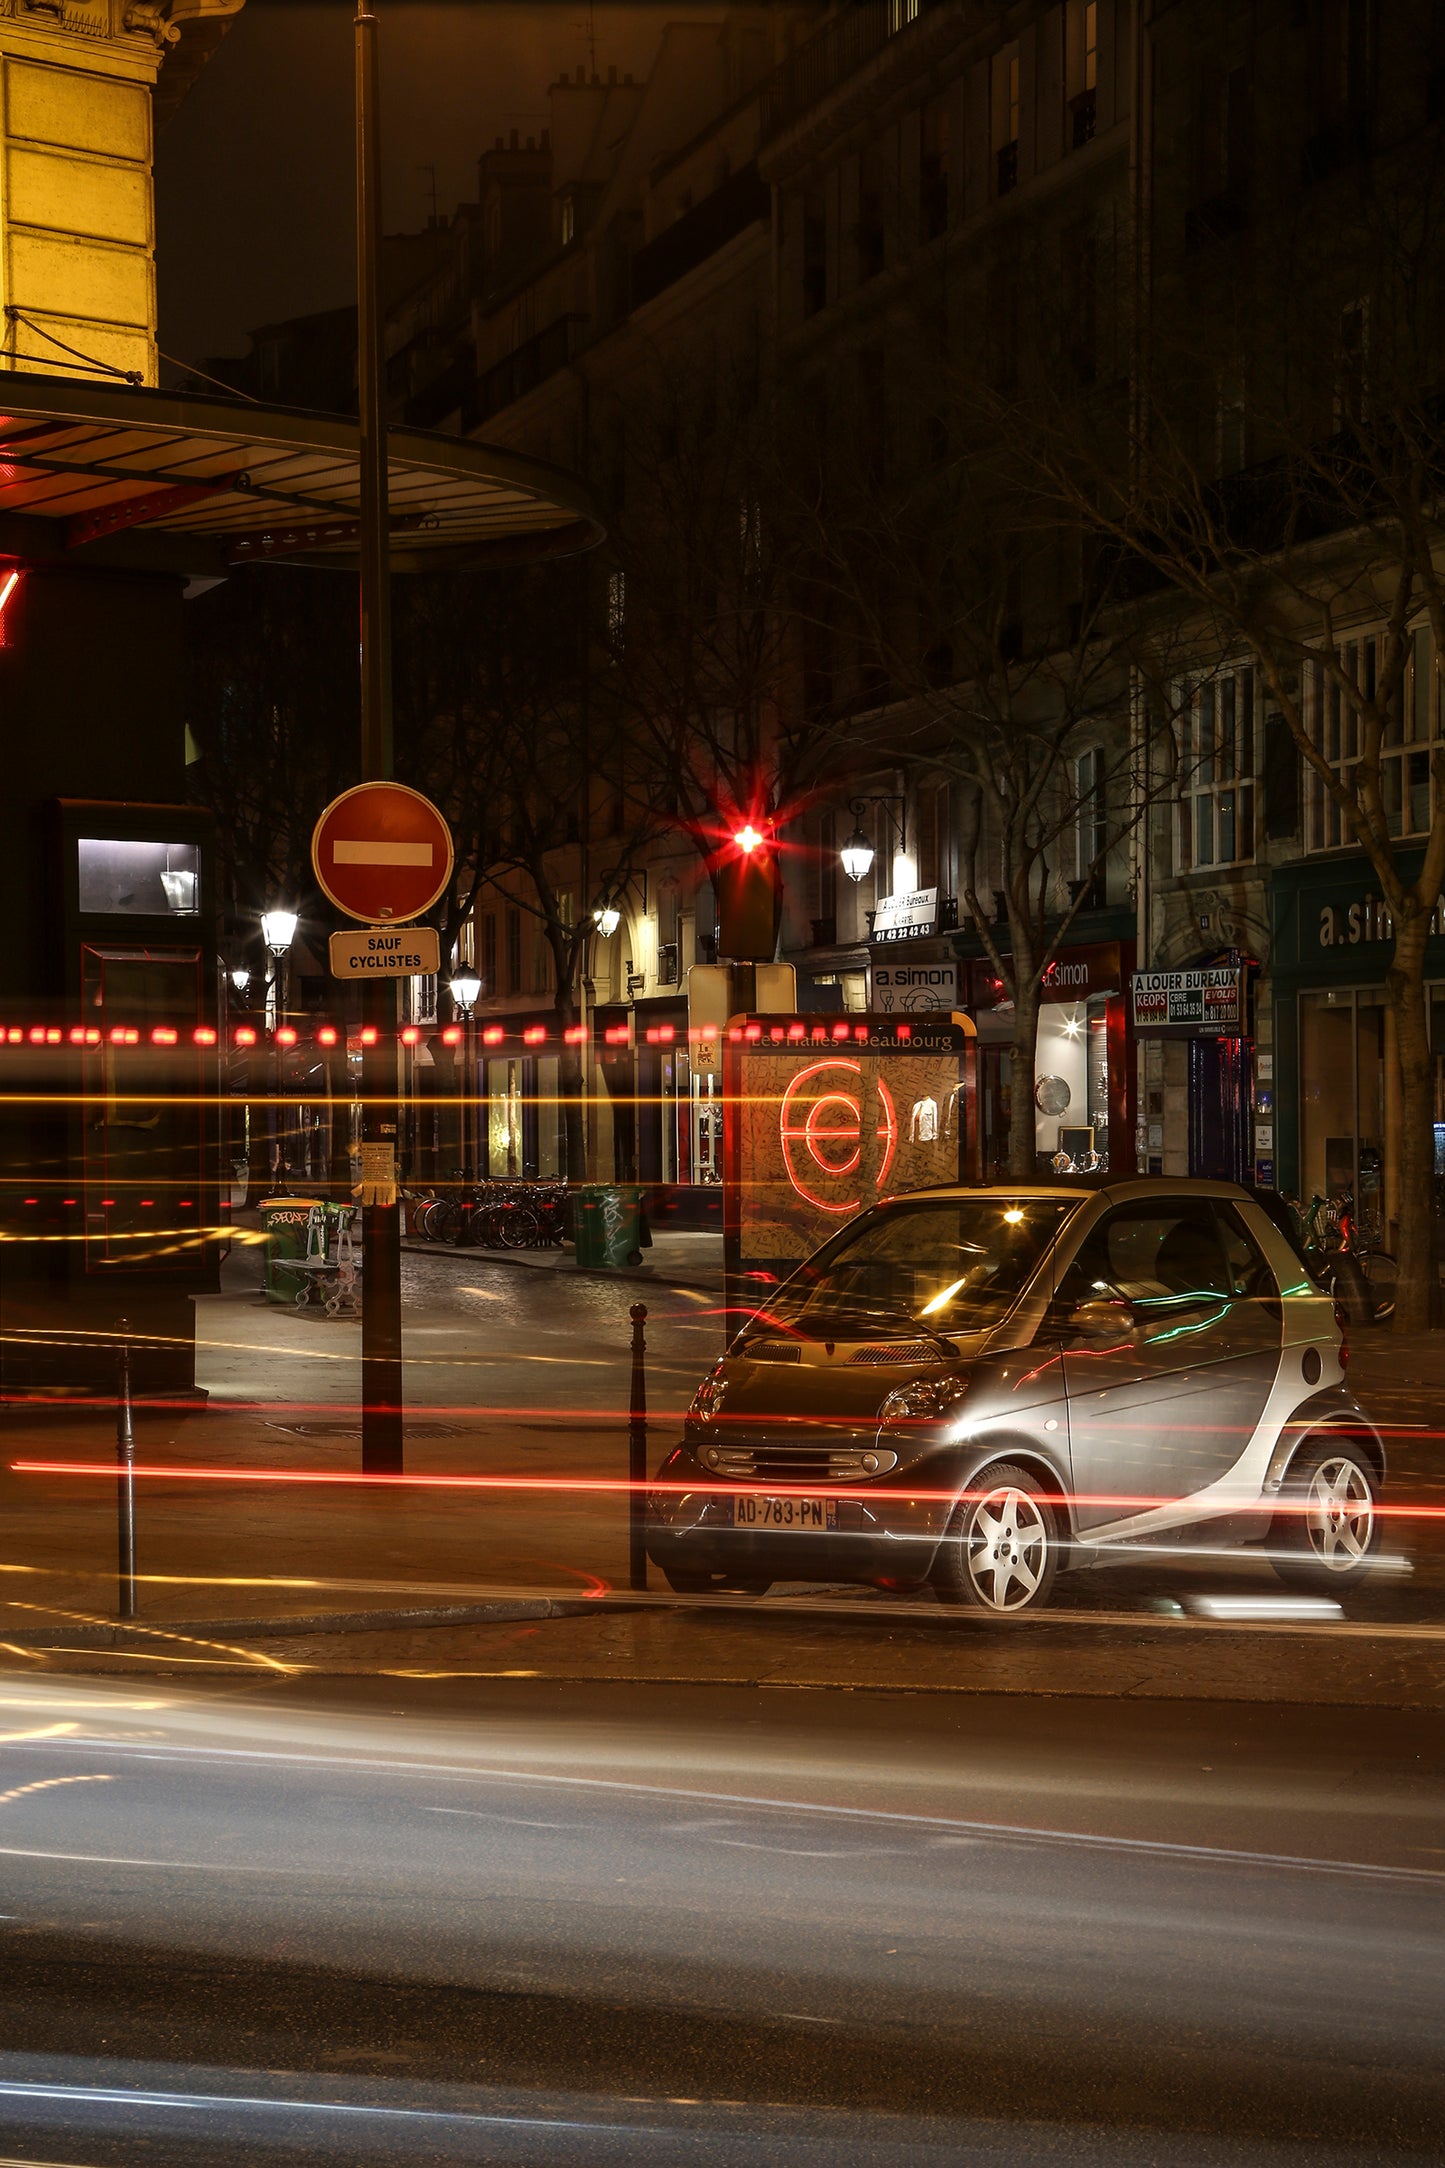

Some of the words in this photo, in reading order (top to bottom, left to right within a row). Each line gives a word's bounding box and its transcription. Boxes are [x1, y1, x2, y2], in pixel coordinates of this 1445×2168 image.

[876, 931, 885, 942] 01
[886, 929, 897, 940] 42
[897, 928, 908, 939] 22
[908, 926, 919, 937] 42
[920, 924, 930, 935] 43
[368, 938, 402, 950] SAUF
[349, 954, 422, 969] CYCLISTES
[875, 967, 954, 986] a.simon
[1135, 976, 1144, 991] A
[1147, 974, 1182, 991] LOUER
[1186, 970, 1237, 989] BUREAUX
[1136, 993, 1166, 1007] KEOPS
[1169, 993, 1187, 1003] CBRE
[1205, 989, 1237, 1000] EVOLIS
[751, 1033, 780, 1047] Les
[786, 1030, 840, 1047] Halles
[858, 1033, 953, 1051] Beaubourg
[738, 1498, 822, 1525] AD-783-PN
[827, 1516, 837, 1526] 75
